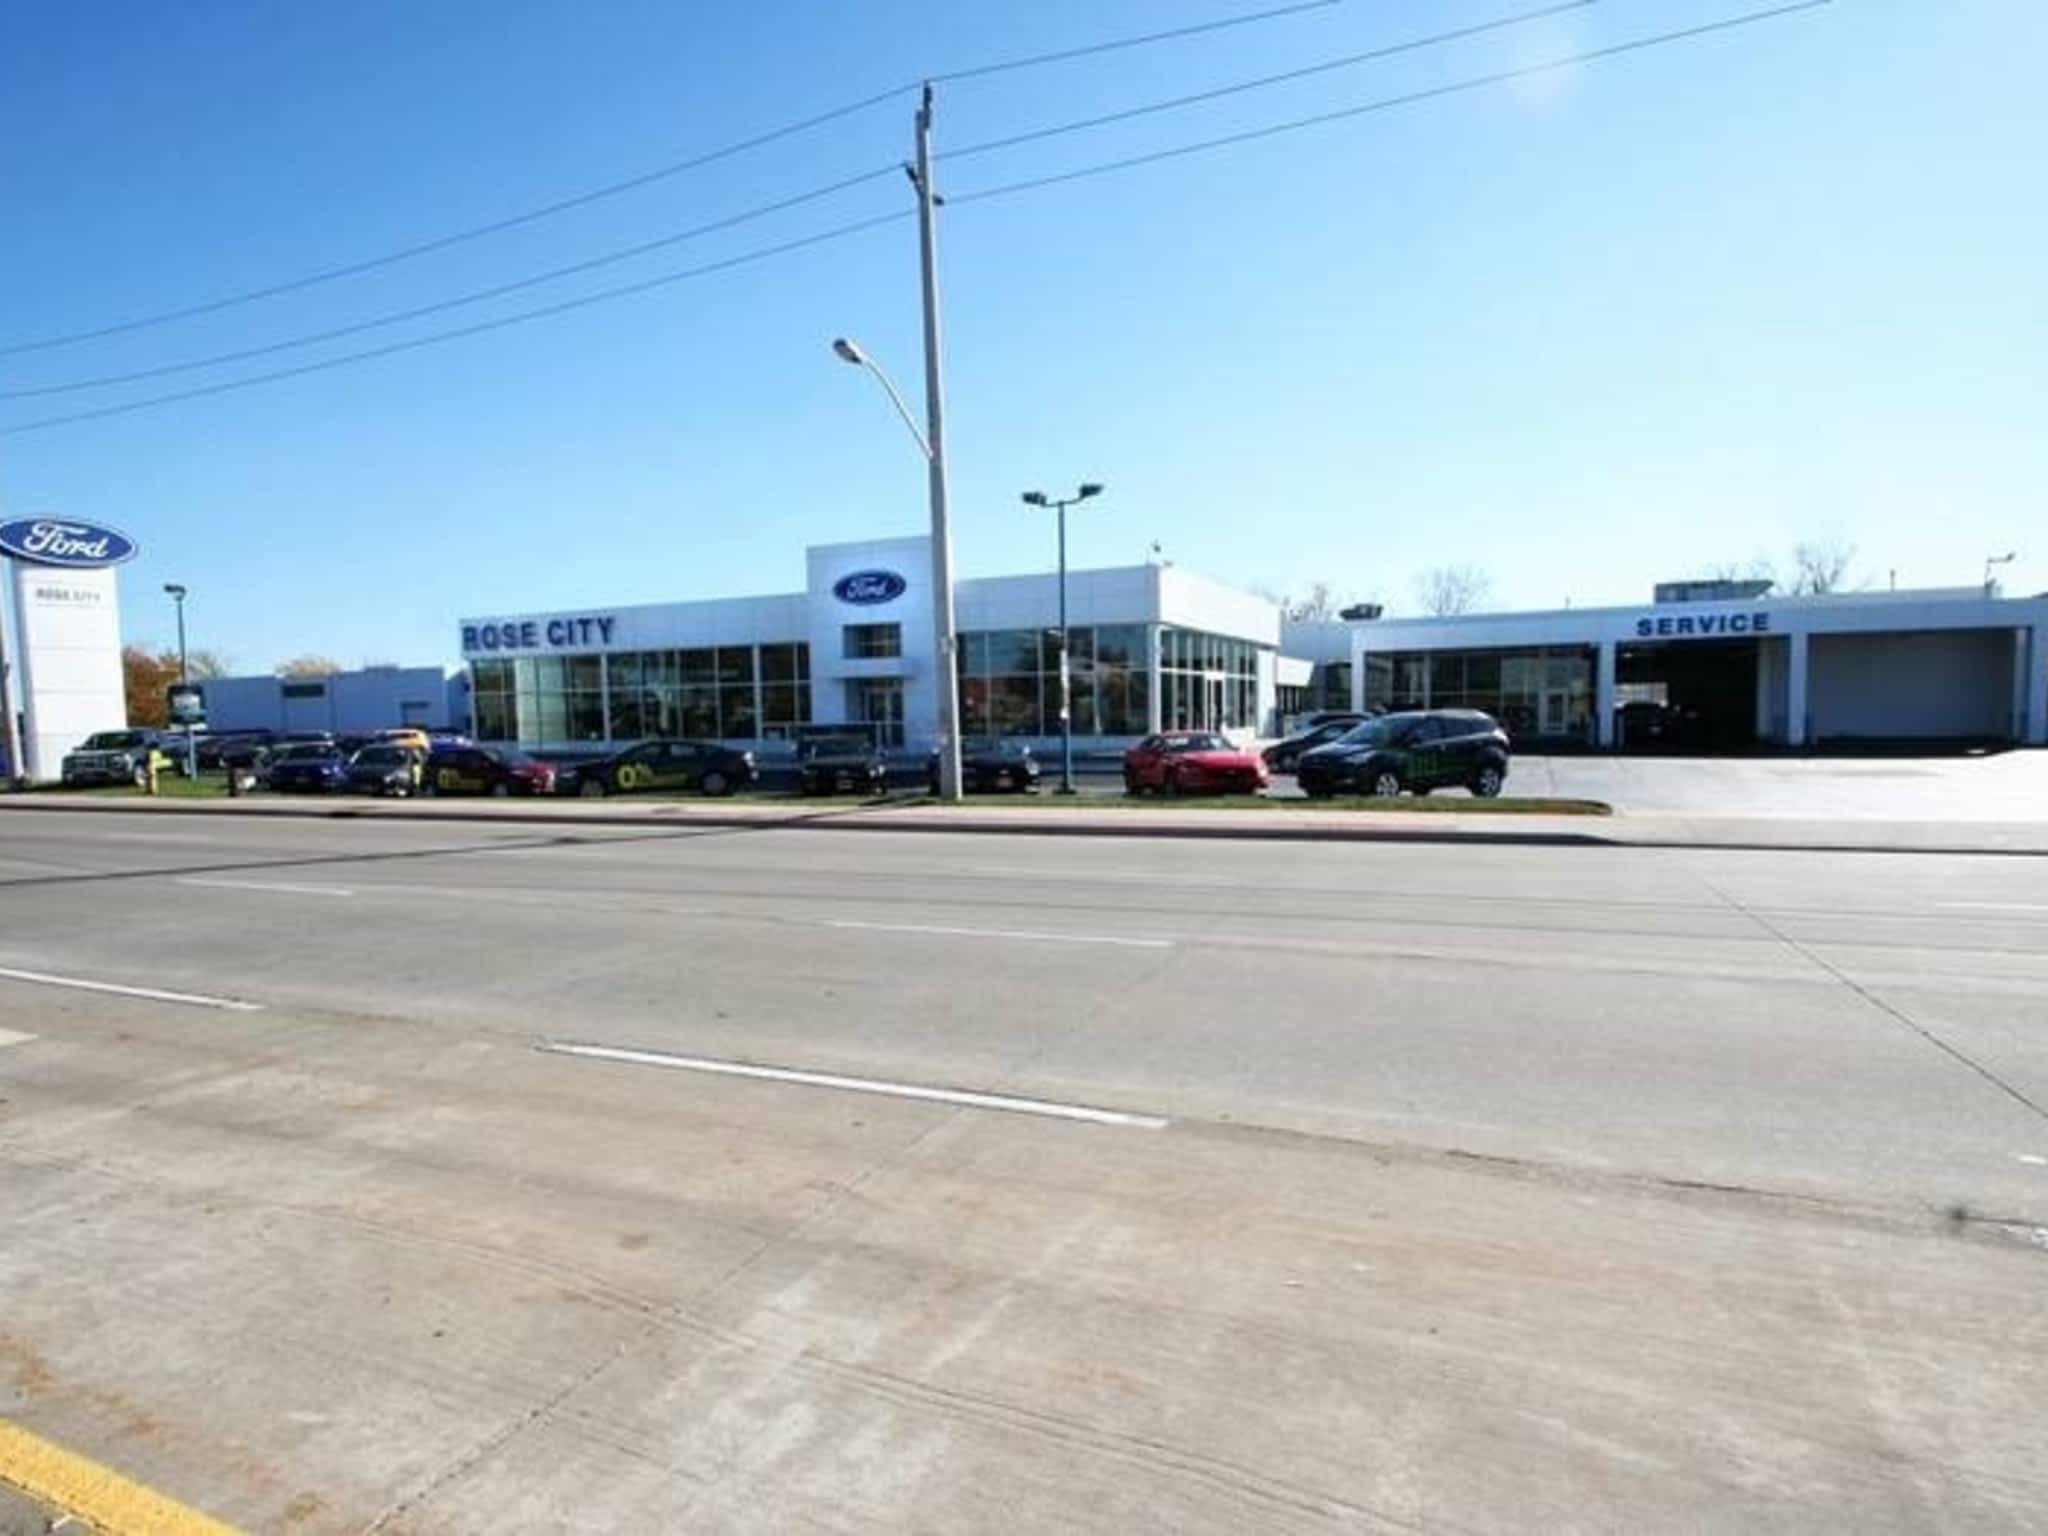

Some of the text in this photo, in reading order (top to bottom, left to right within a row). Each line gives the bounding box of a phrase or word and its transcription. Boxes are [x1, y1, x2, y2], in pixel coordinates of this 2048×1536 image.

[23, 520, 110, 558] Ford
[847, 575, 888, 599] Ford
[461, 616, 616, 652] ROSE CITY
[1636, 611, 1770, 637] SERVICE
